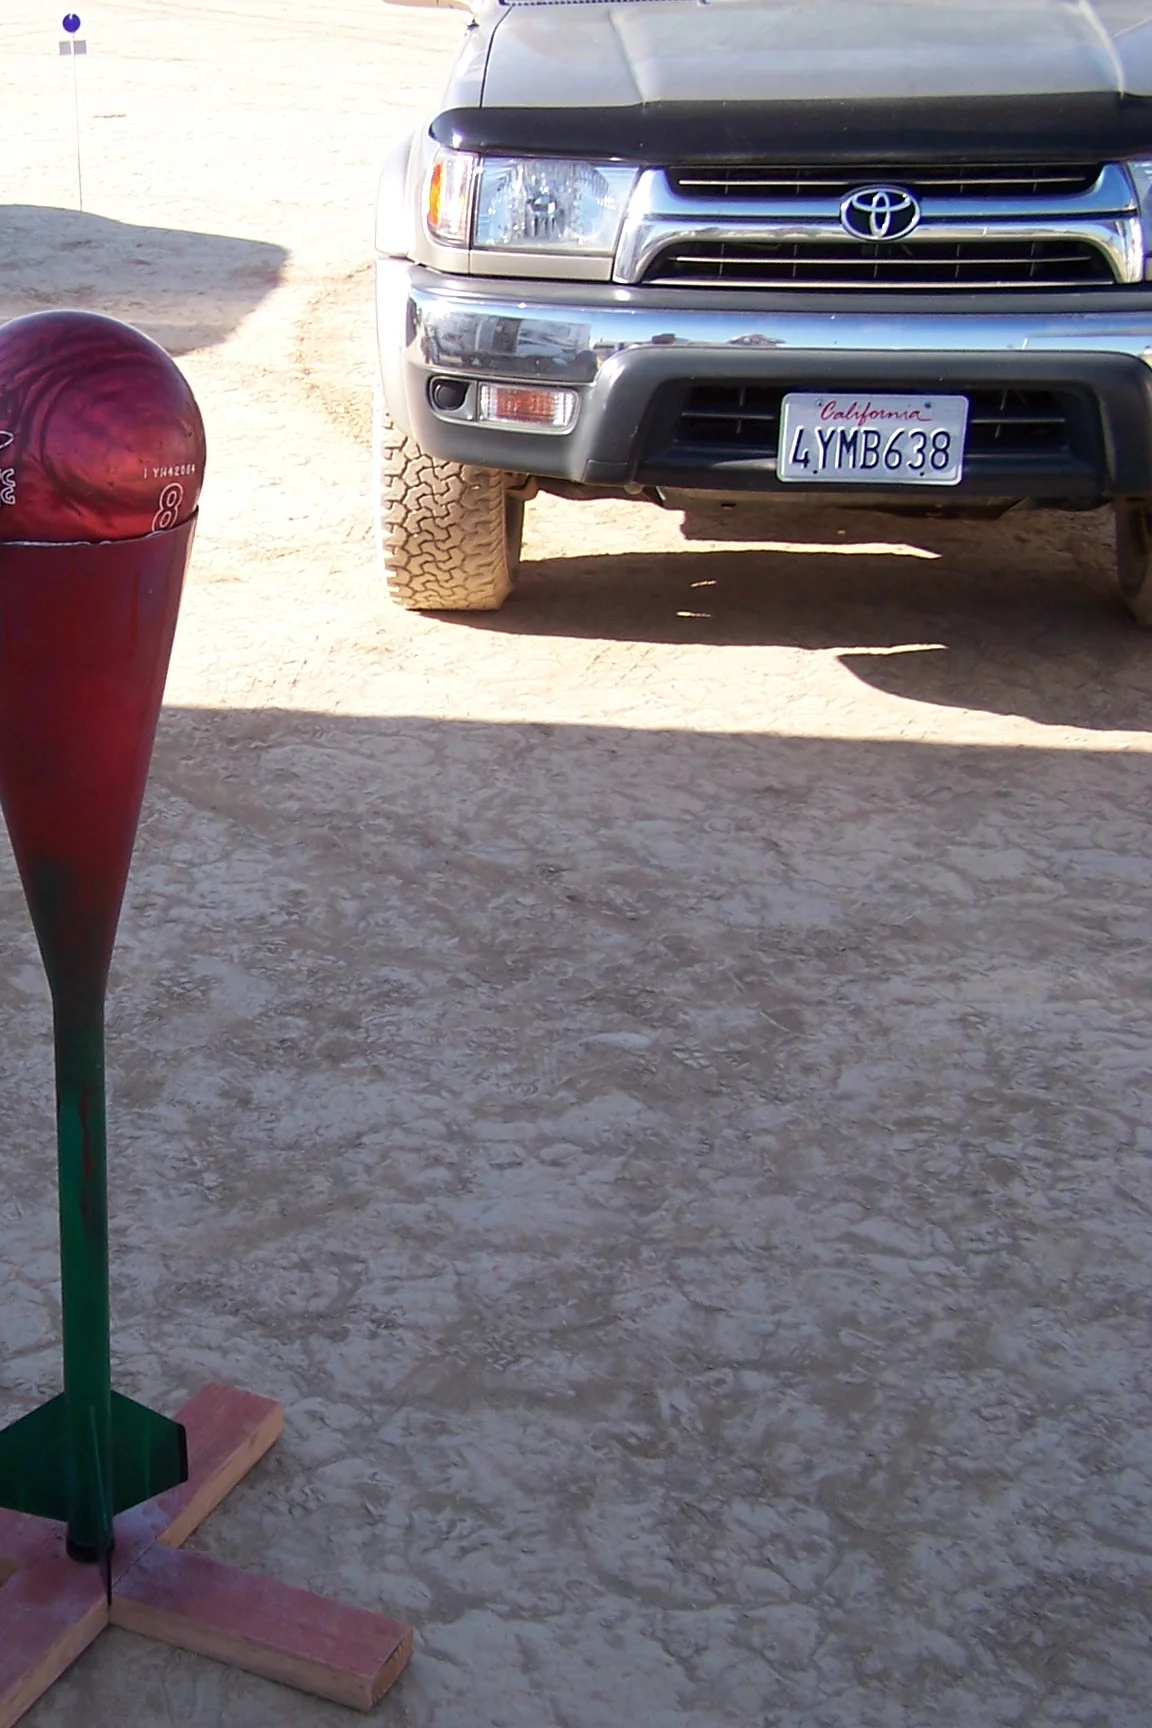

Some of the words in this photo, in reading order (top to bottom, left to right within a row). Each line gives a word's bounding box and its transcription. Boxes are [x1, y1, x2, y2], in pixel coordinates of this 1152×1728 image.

[821, 401, 932, 425] California
[789, 427, 951, 471] 4YMB638
[151, 482, 184, 532] 8
